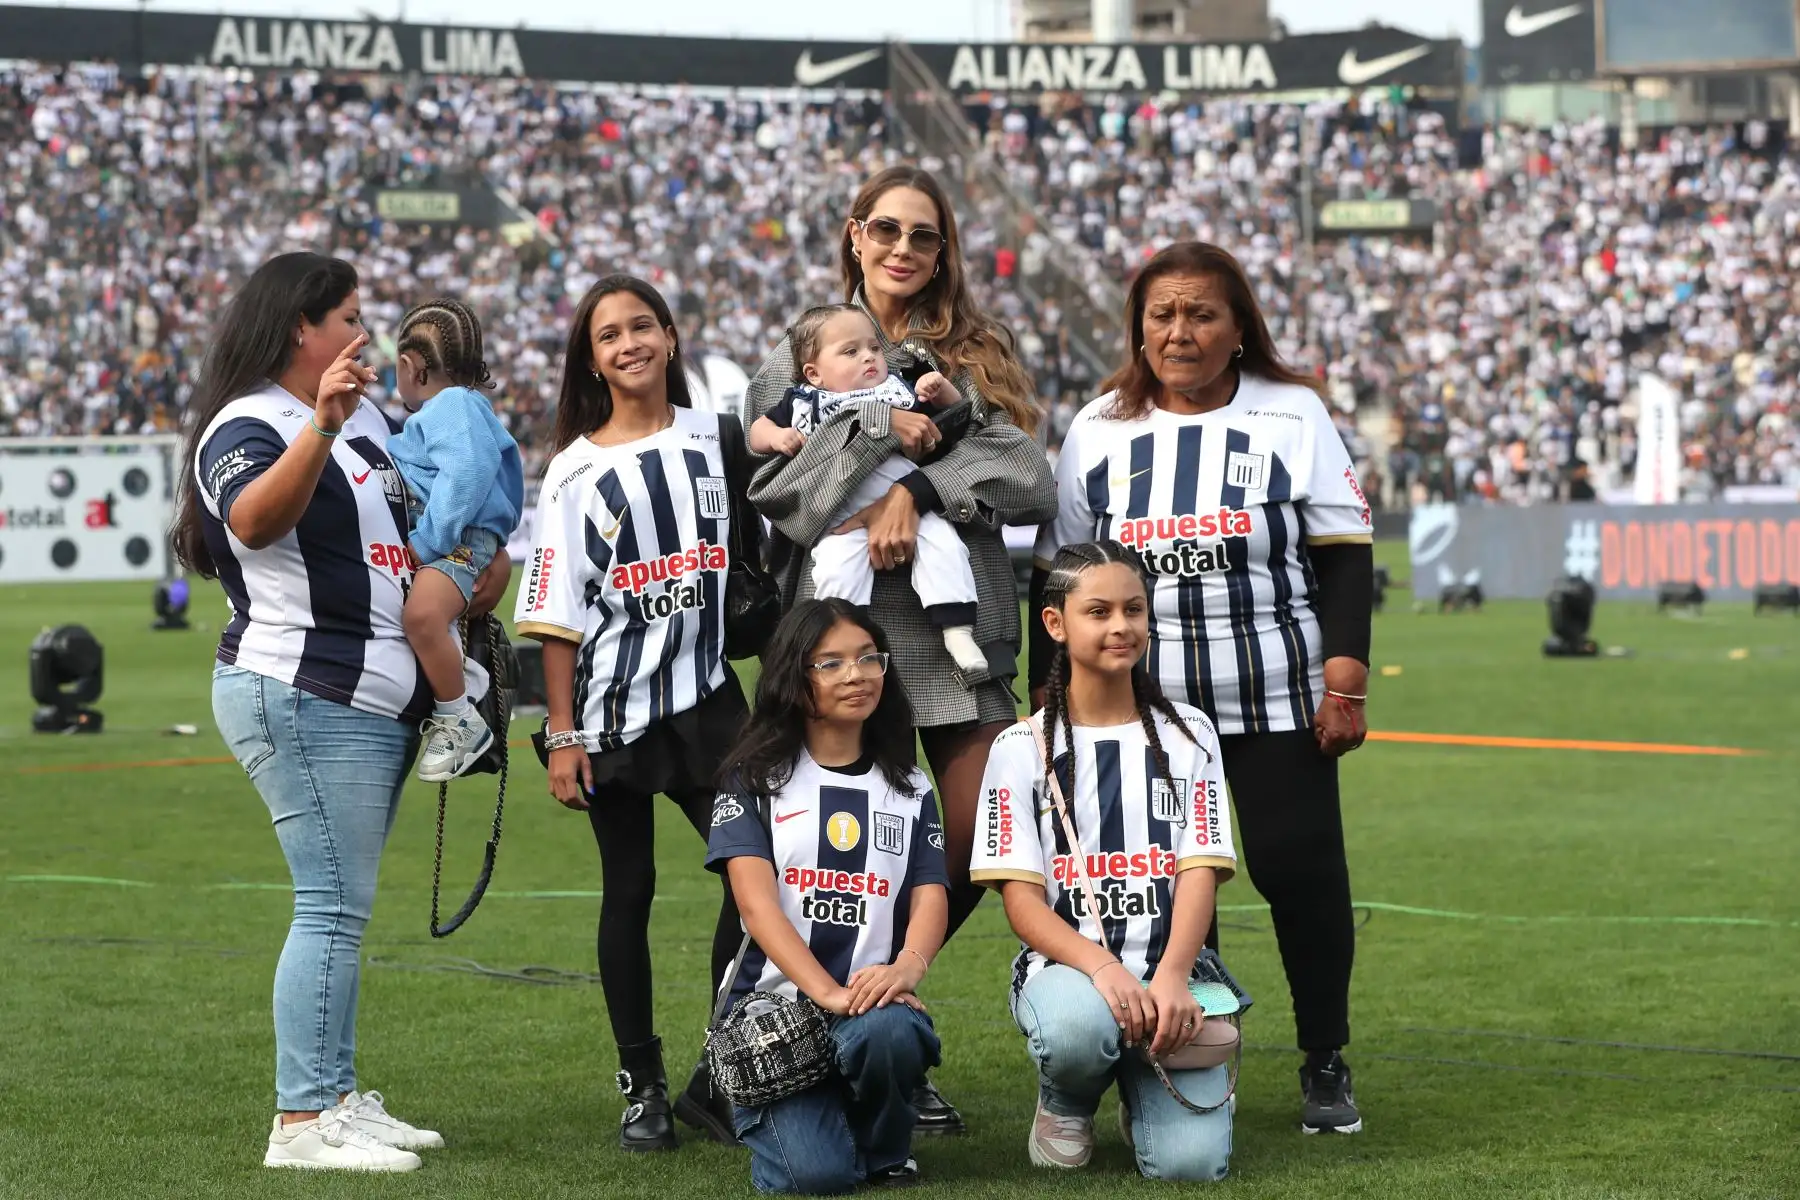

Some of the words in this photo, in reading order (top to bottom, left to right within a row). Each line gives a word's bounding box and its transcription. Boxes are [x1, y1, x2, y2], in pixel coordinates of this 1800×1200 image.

[211, 16, 404, 71] ALIANZA
[420, 27, 526, 76] LIMA
[950, 45, 1147, 90] ALIANZA
[1163, 43, 1278, 90] LIMA
[1263, 411, 1303, 422] HYUNDAI
[558, 461, 595, 489] HYUNDAI
[1119, 507, 1253, 550] apuesta
[368, 542, 417, 577] apu
[533, 547, 556, 613] TORITO
[611, 539, 727, 595] apuesta
[1143, 543, 1231, 576] total
[640, 577, 705, 622] total
[998, 788, 1013, 857] TORITO
[1194, 779, 1209, 846] TORITO
[784, 867, 890, 898] apuesta
[1052, 846, 1176, 887] apuesta
[802, 895, 868, 926] total
[1071, 884, 1159, 917] total
